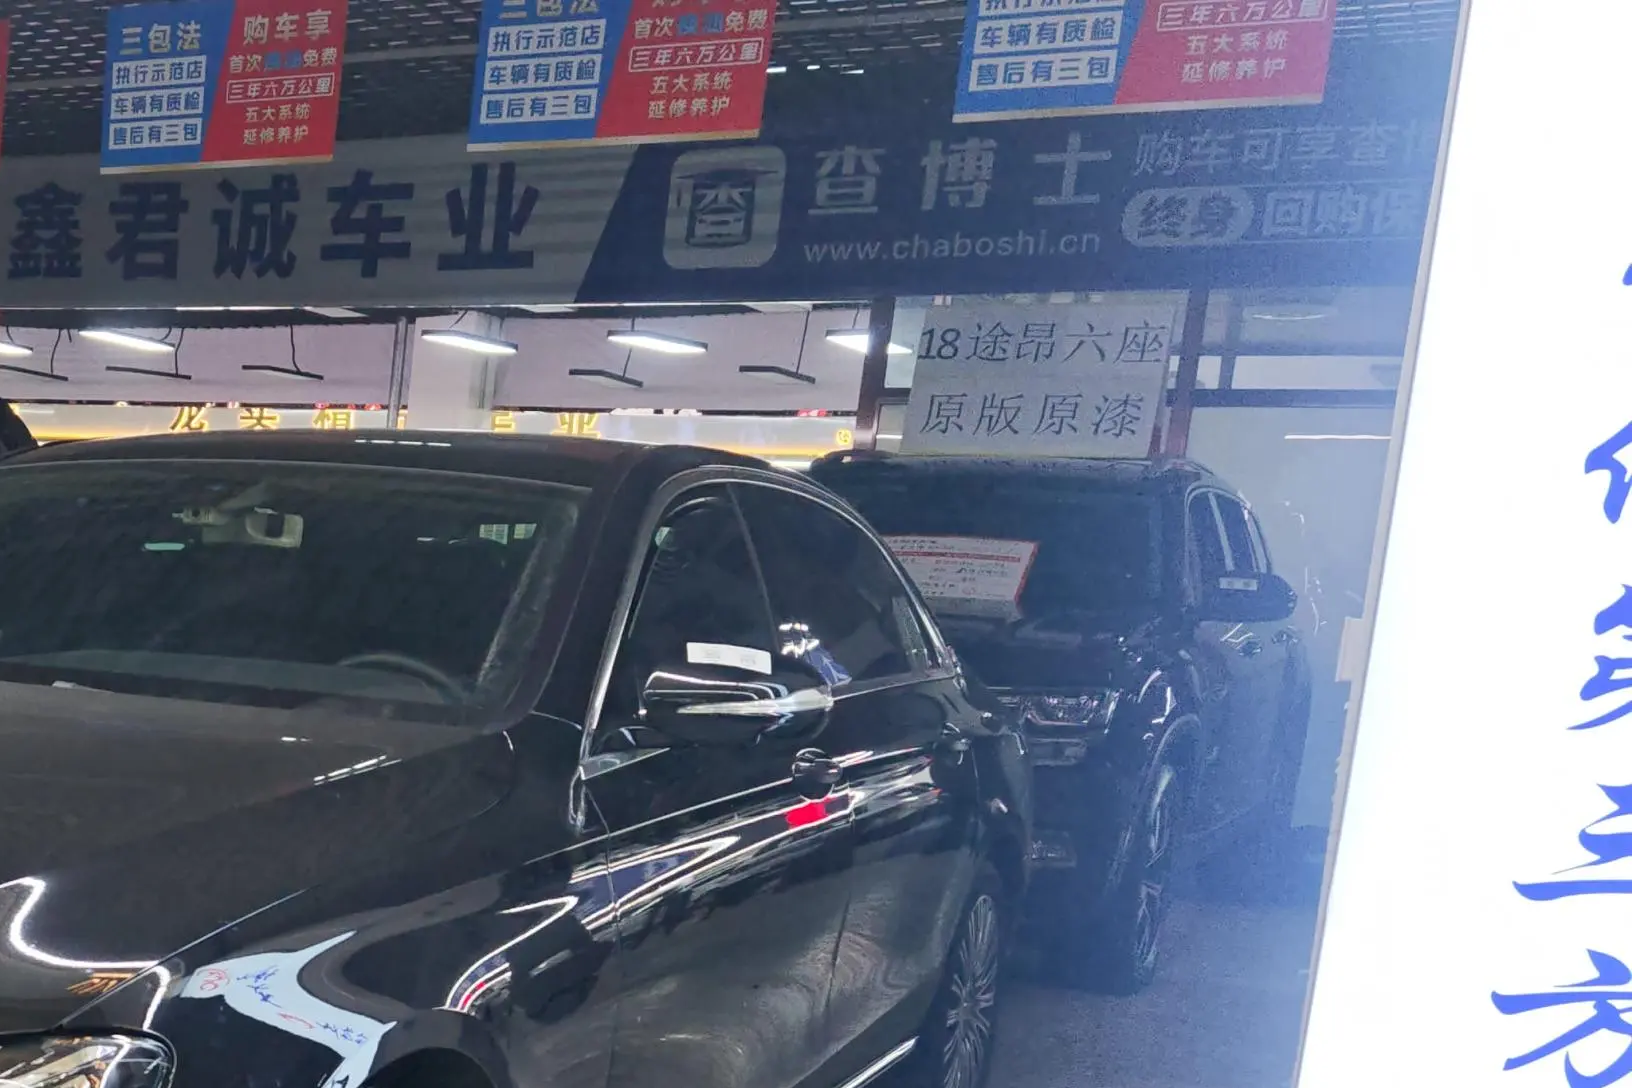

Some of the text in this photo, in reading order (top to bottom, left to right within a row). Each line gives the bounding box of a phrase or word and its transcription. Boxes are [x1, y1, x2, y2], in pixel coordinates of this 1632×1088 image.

[120, 20, 201, 55] 三包法
[243, 9, 332, 45] 购车享
[492, 24, 601, 52] 执行示范店
[981, 17, 1117, 49] 车辆有质检
[1186, 29, 1289, 55] 五大系统
[633, 42, 761, 69] 三年六万公里
[116, 60, 203, 86] 执行示范店
[489, 60, 597, 85] 车辆有质检
[651, 71, 733, 95] 五大系统
[976, 56, 1111, 86] 售后有三包
[1182, 58, 1286, 83] 延修养护
[229, 77, 332, 99] 三年六万公里
[113, 91, 200, 115] 车辆有质检
[245, 103, 311, 123] 五大系统
[485, 94, 593, 119] 售后有三包
[648, 96, 730, 119] 延修养护
[113, 123, 201, 146] 售后有三包
[243, 125, 309, 145] 延修养护
[807, 131, 1112, 215] 查博士
[6, 160, 541, 281] 鑫君诚车业
[803, 229, 1101, 264] www.chaboshi.cn
[917, 320, 1167, 364] 18途昂六座
[919, 392, 1146, 439] 原版原漆
